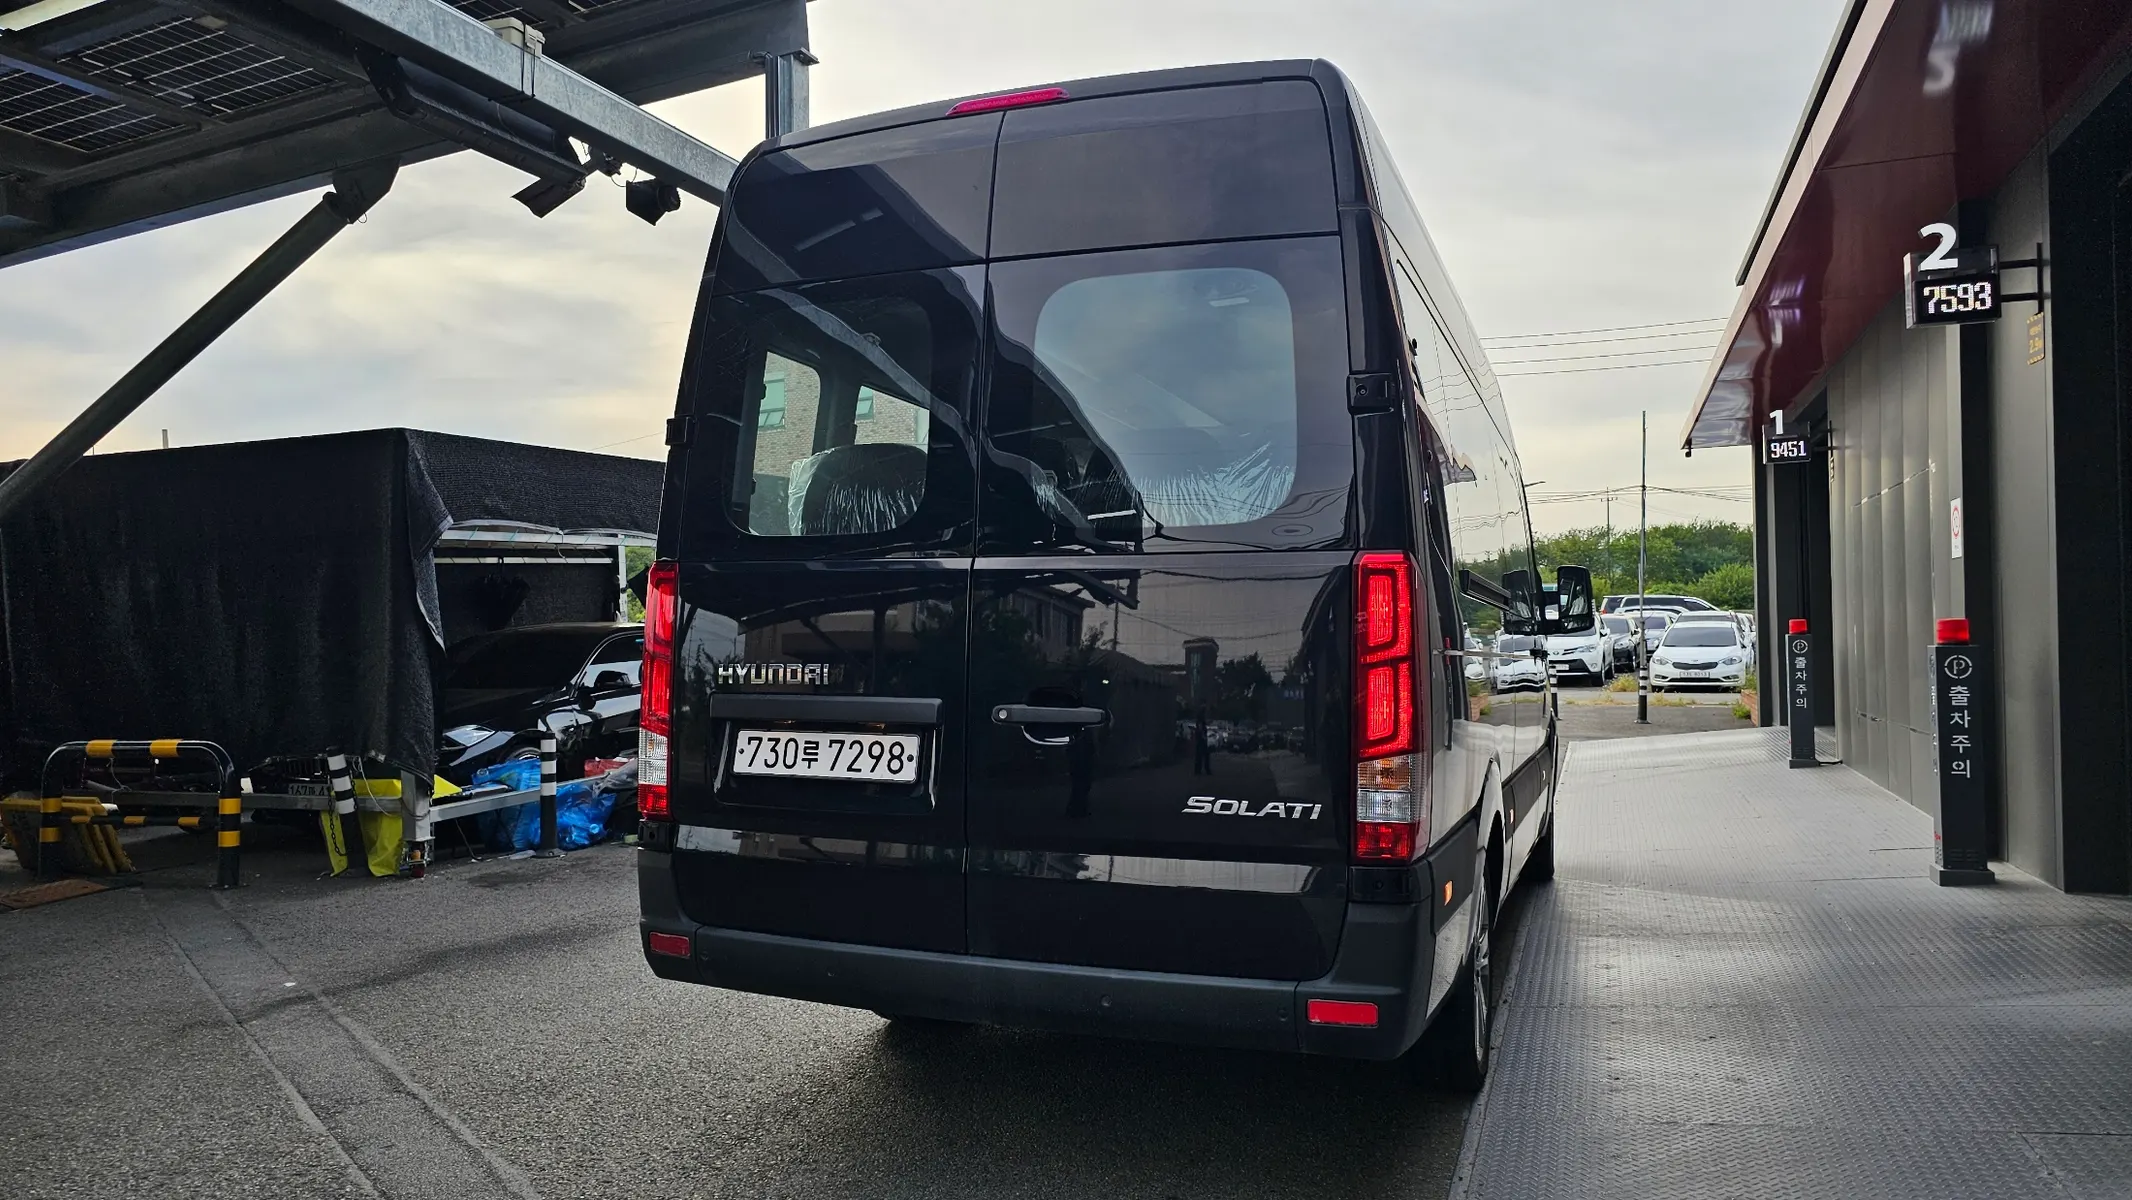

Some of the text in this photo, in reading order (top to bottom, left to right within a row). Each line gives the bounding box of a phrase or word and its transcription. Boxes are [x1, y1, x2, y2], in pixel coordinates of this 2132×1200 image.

[1918, 222, 1959, 272] 2
[1923, 281, 1992, 314] 7593
[1769, 409, 1784, 435] 1
[1770, 440, 1807, 458] 9451
[718, 663, 830, 685] HYUNDAI
[1949, 685, 1971, 778] 출차주의
[747, 736, 905, 775] 730루 7298
[1181, 796, 1322, 820] SOLATI
